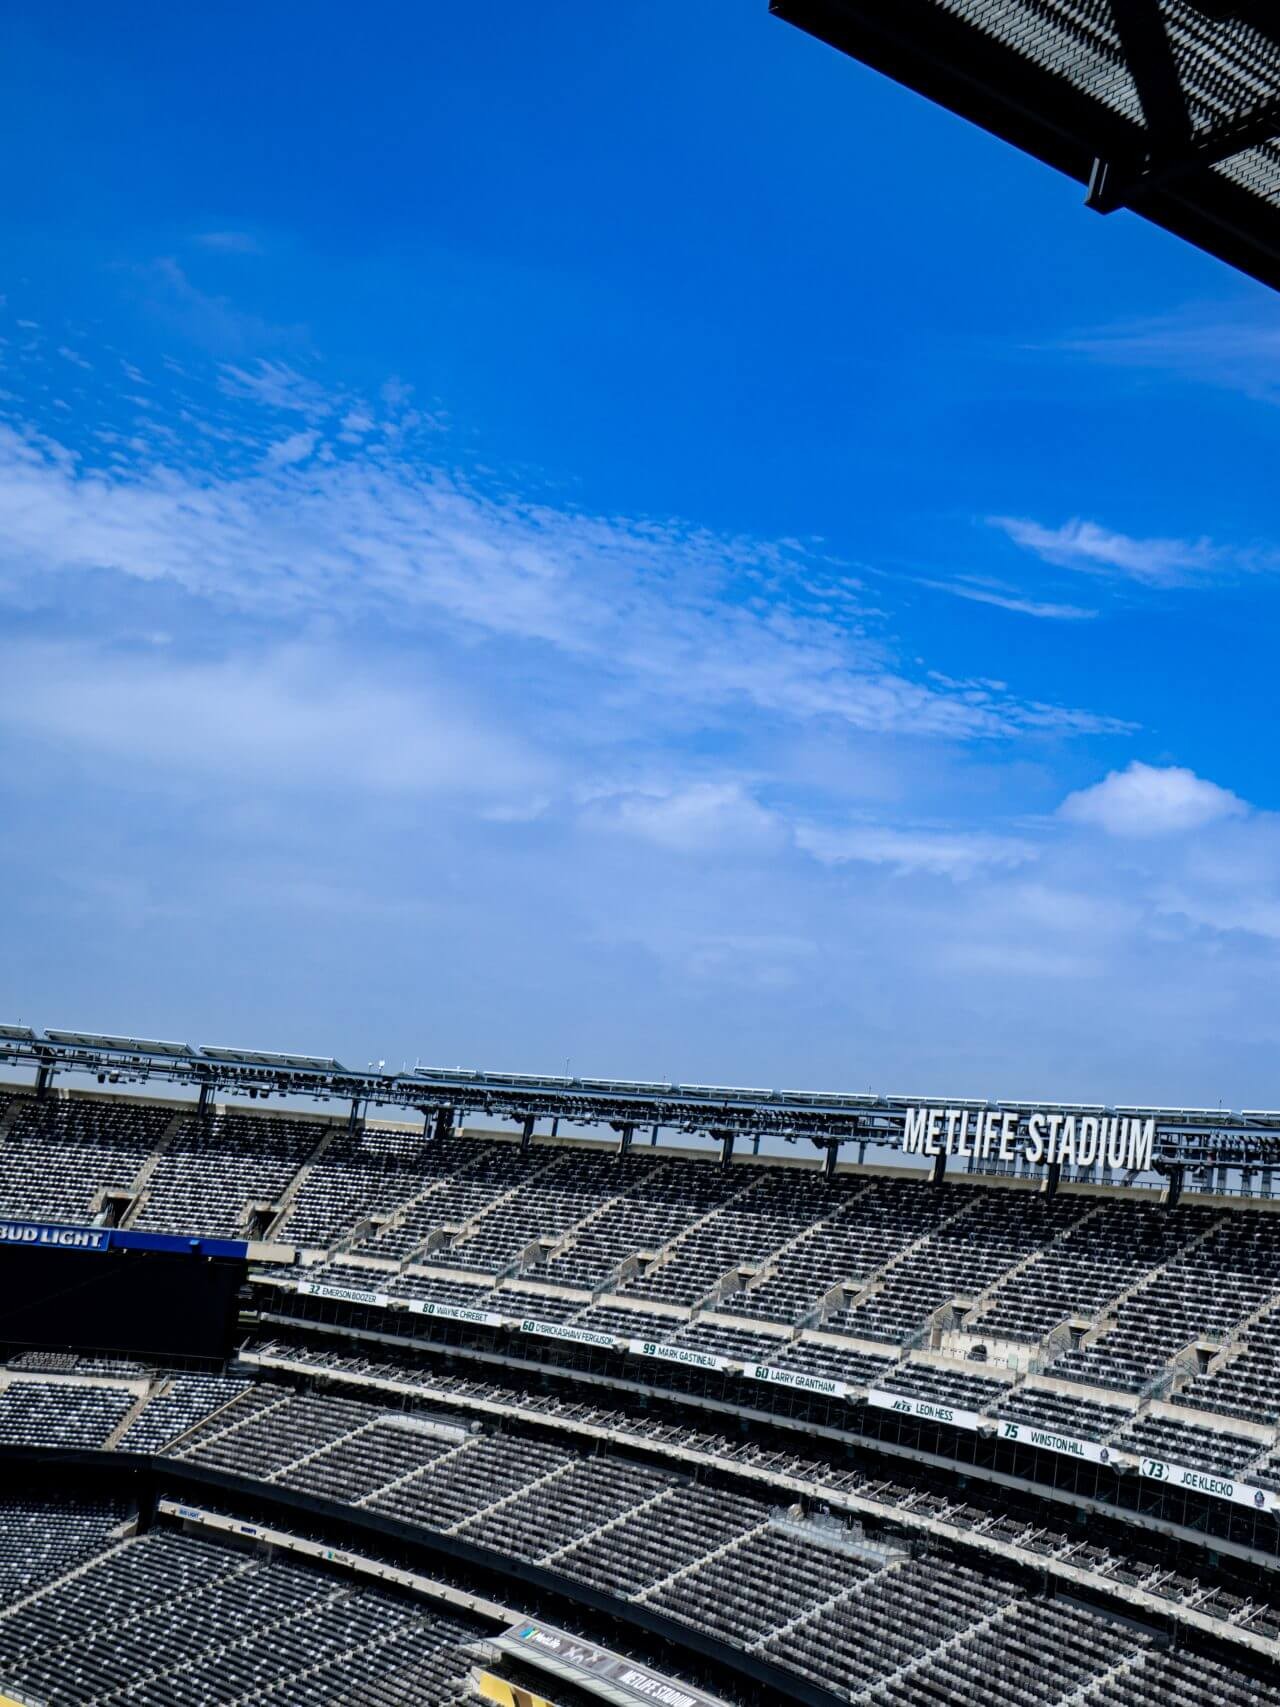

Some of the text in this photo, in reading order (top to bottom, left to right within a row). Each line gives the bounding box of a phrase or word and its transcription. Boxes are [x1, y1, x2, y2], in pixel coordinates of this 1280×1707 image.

[902, 1108, 1155, 1171] METLIFE STADIUM
[0, 1225, 103, 1248] BUD LIGHT
[309, 1284, 377, 1303] 32 EMERSON BOOZER
[423, 1303, 489, 1322] 80 WAYNE CHREBET
[522, 1320, 535, 1332] 60
[582, 1332, 614, 1345] FERGUSON
[643, 1343, 717, 1367] 99 MARK GASTINEAU
[754, 1367, 836, 1393] 60 LARRY GRANTHAM
[891, 1400, 953, 1421] JETS LEON HESS
[1003, 1423, 1085, 1456] 75 WINSTON HILL
[1180, 1471, 1200, 1489] JOE
[1199, 1476, 1234, 1498] KLECKO
[618, 1669, 662, 1695] METLIFE
